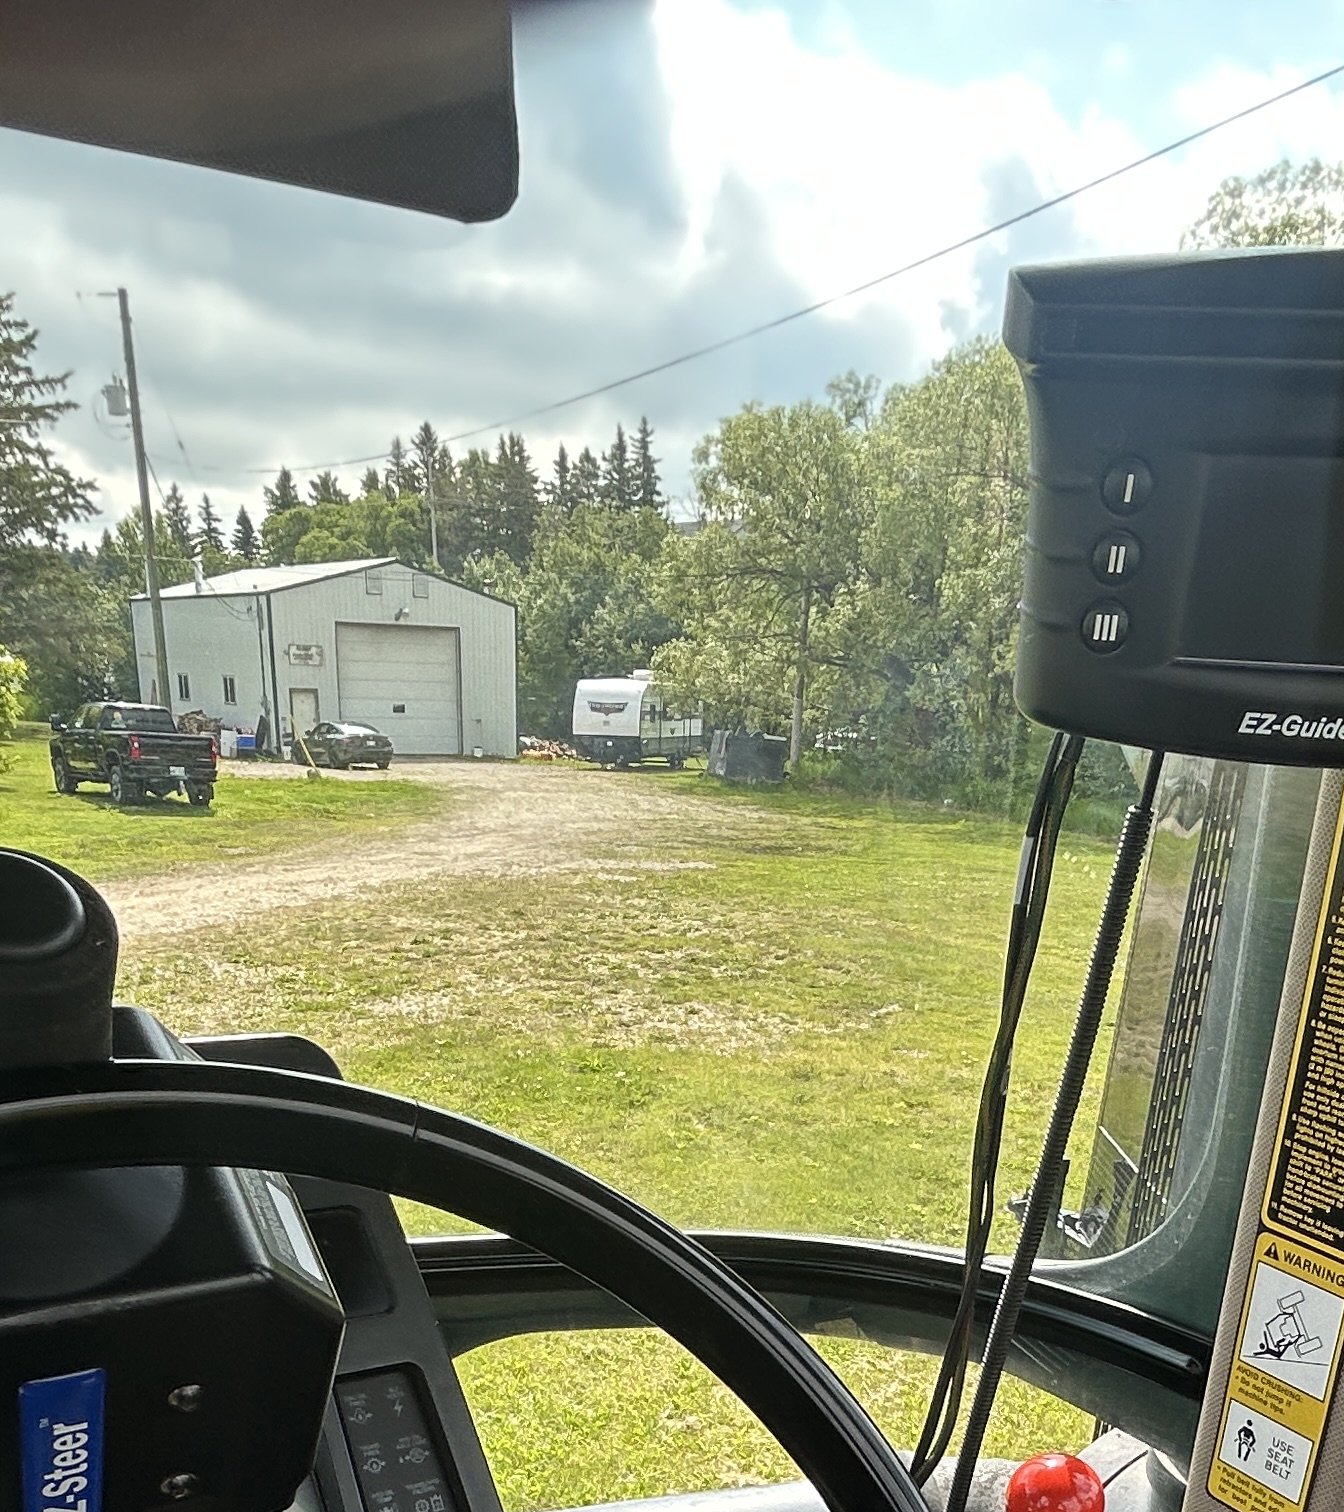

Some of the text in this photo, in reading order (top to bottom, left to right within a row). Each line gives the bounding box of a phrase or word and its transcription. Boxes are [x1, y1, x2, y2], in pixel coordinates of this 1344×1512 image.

[1236, 1365, 1259, 1380] AVOID
[1240, 1376, 1284, 1404] Do not jump
[1273, 1437, 1295, 1456] USE
[1268, 1448, 1294, 1469] SEAT
[1265, 1460, 1291, 1480] BELT
